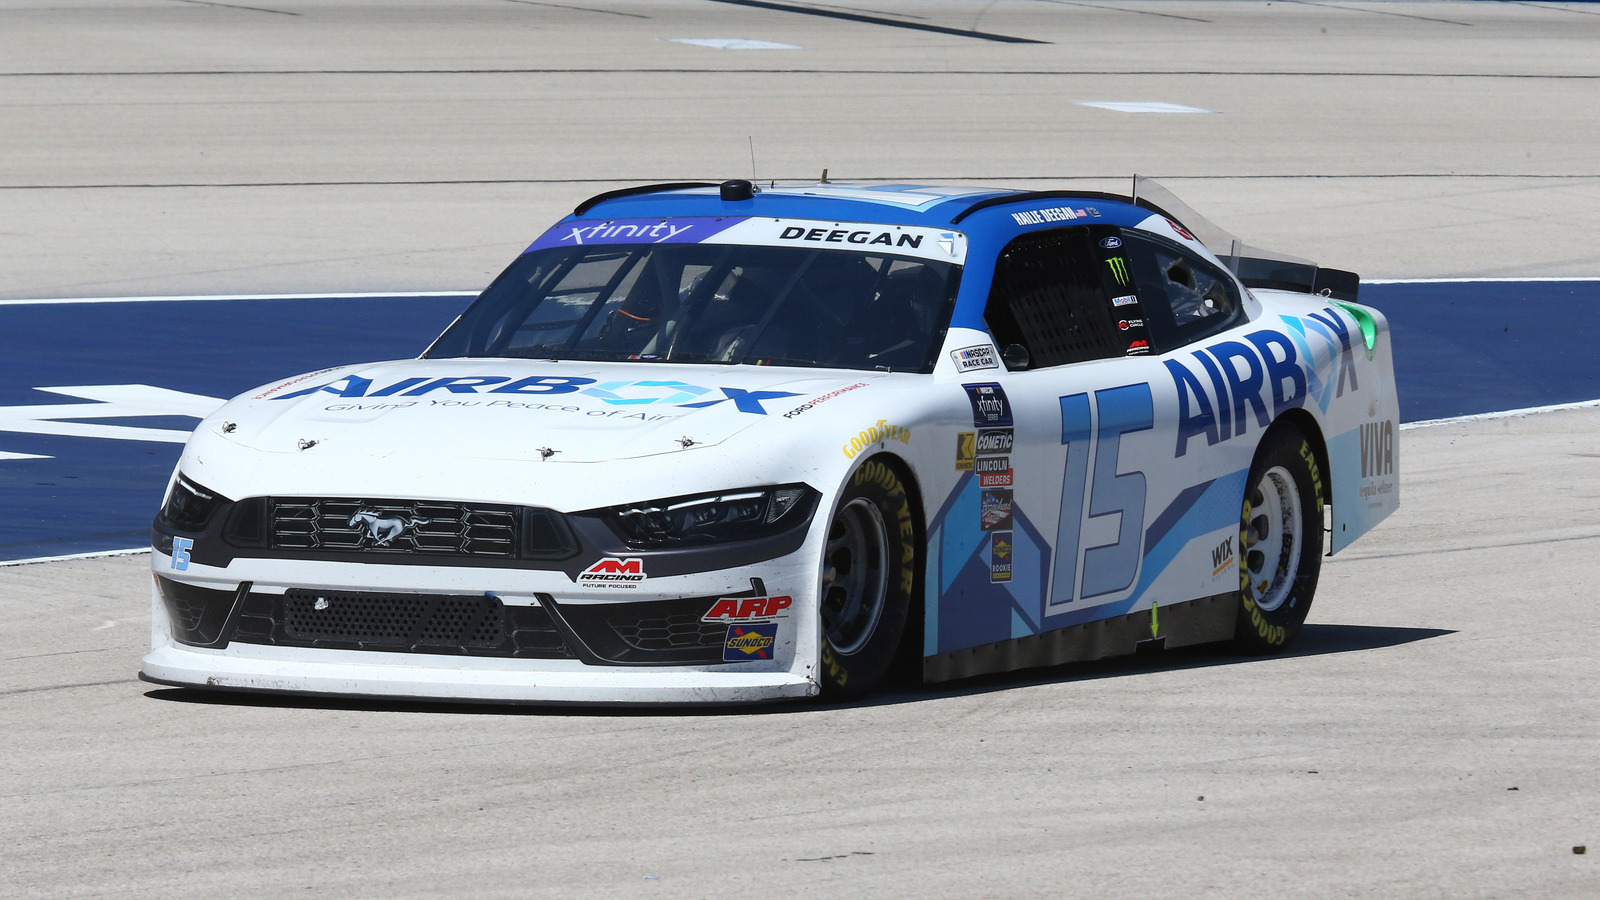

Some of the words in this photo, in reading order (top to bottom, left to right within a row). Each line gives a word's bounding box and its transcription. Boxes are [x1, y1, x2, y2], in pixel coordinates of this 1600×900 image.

[1011, 211, 1044, 225] HAILIE
[1039, 207, 1077, 222] DEEGAN
[561, 221, 694, 245] xfinity
[779, 226, 924, 249] DEEGAN
[962, 359, 981, 368] RACE
[981, 357, 993, 366] CAR
[966, 348, 991, 358] NASCAR
[1163, 308, 1358, 458] AIRBOX
[267, 374, 811, 415] AIRBOX
[325, 401, 419, 411] Giving
[486, 400, 580, 413] Peace
[586, 409, 626, 417] of
[977, 395, 1003, 417] xfinity
[977, 433, 1013, 450] COMETIC
[1360, 420, 1393, 478] VIVA
[976, 458, 1008, 471] LINCOLN
[983, 474, 1011, 485] WELDERS
[1300, 440, 1324, 513] EAGLE
[1050, 382, 1154, 606] 15
[171, 536, 194, 571] 15
[1212, 535, 1234, 568] WIX
[588, 560, 640, 575] AM
[992, 564, 1011, 572] ROOKIE
[580, 574, 643, 582] RACING
[706, 596, 792, 618] ARP
[729, 637, 772, 648] SUNOCO
